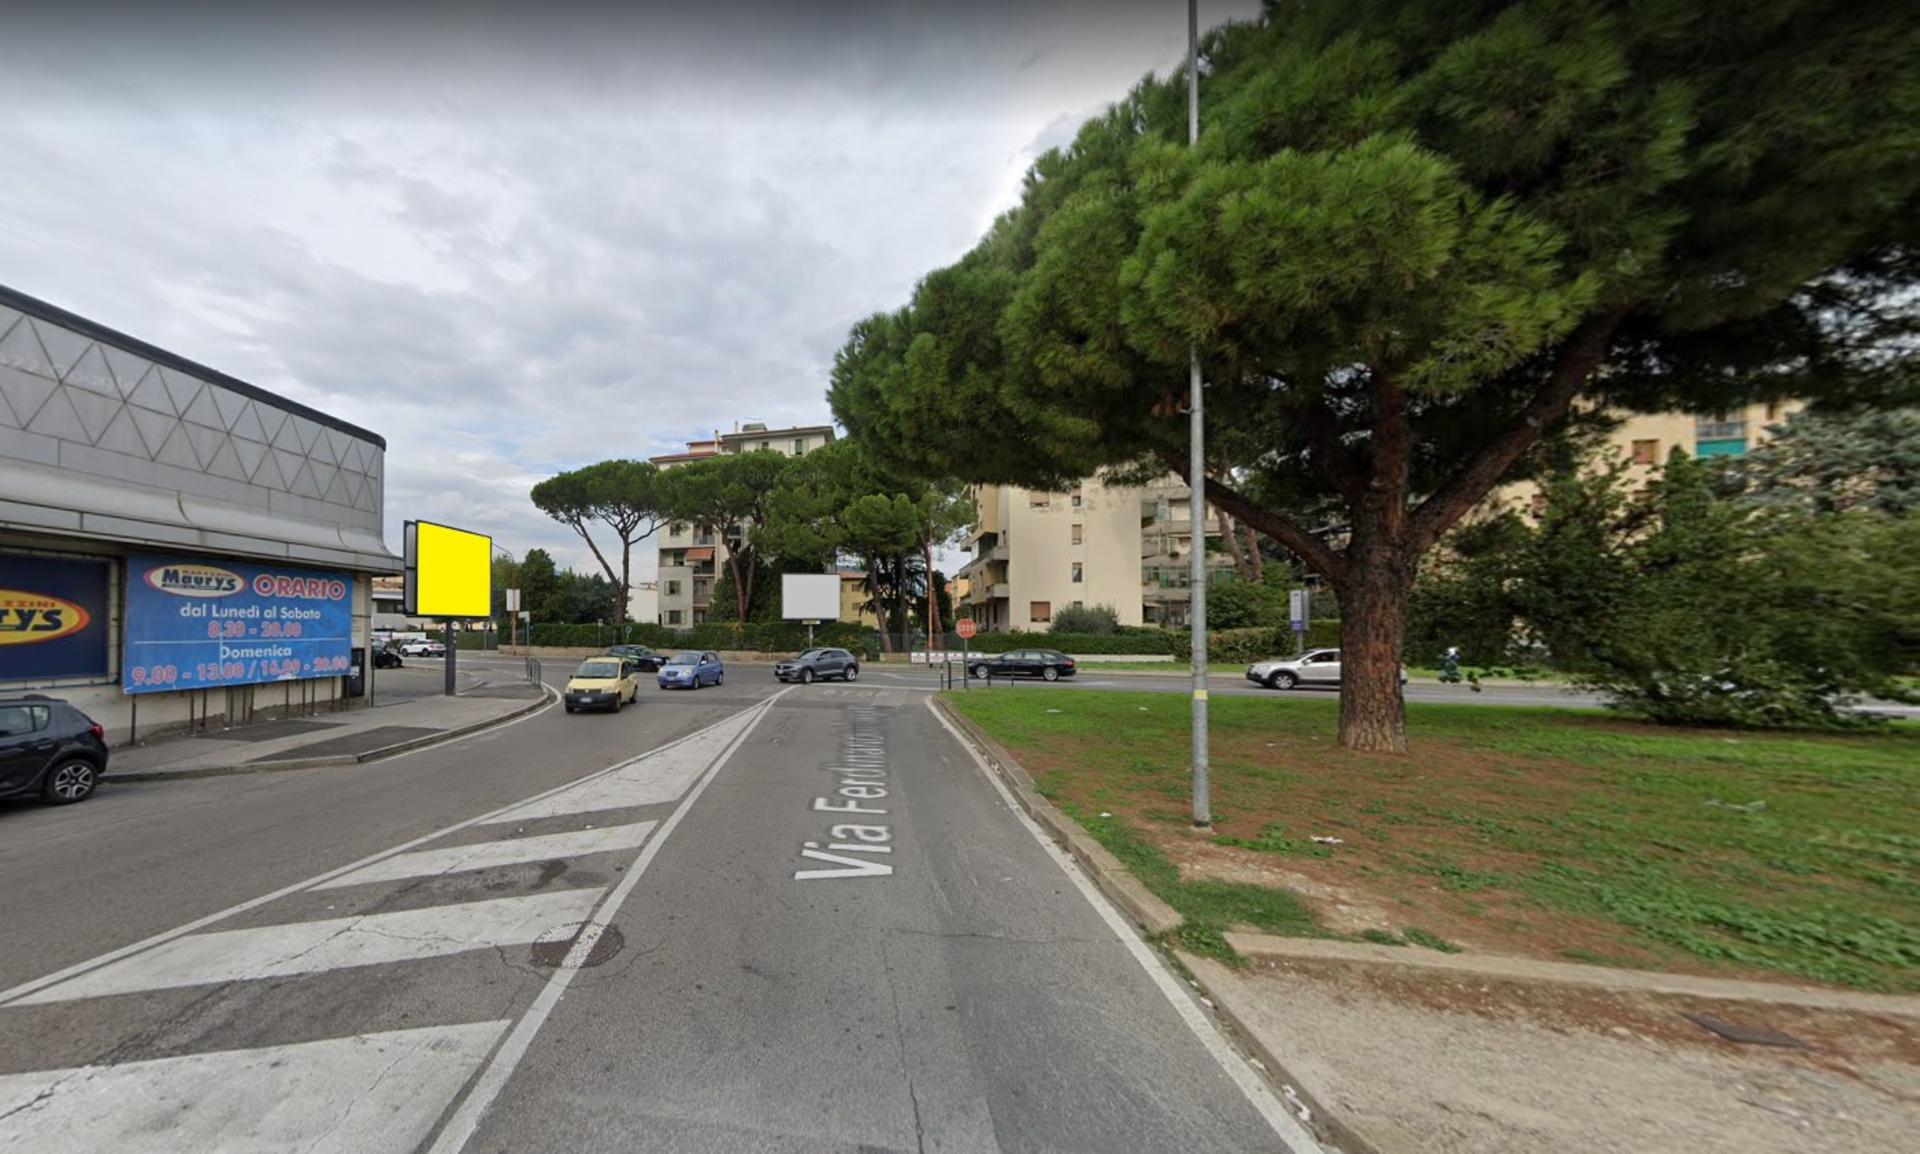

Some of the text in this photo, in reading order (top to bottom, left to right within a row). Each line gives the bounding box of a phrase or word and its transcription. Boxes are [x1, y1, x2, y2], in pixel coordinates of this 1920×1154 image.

[253, 574, 346, 601] ORARIO
[180, 602, 321, 620] dal Lunedì al Sabato
[207, 620, 245, 639] 8.30
[260, 621, 302, 638] 20.00
[220, 645, 292, 659] Domenica
[131, 665, 178, 687] 9.00
[197, 662, 245, 681] 13.00
